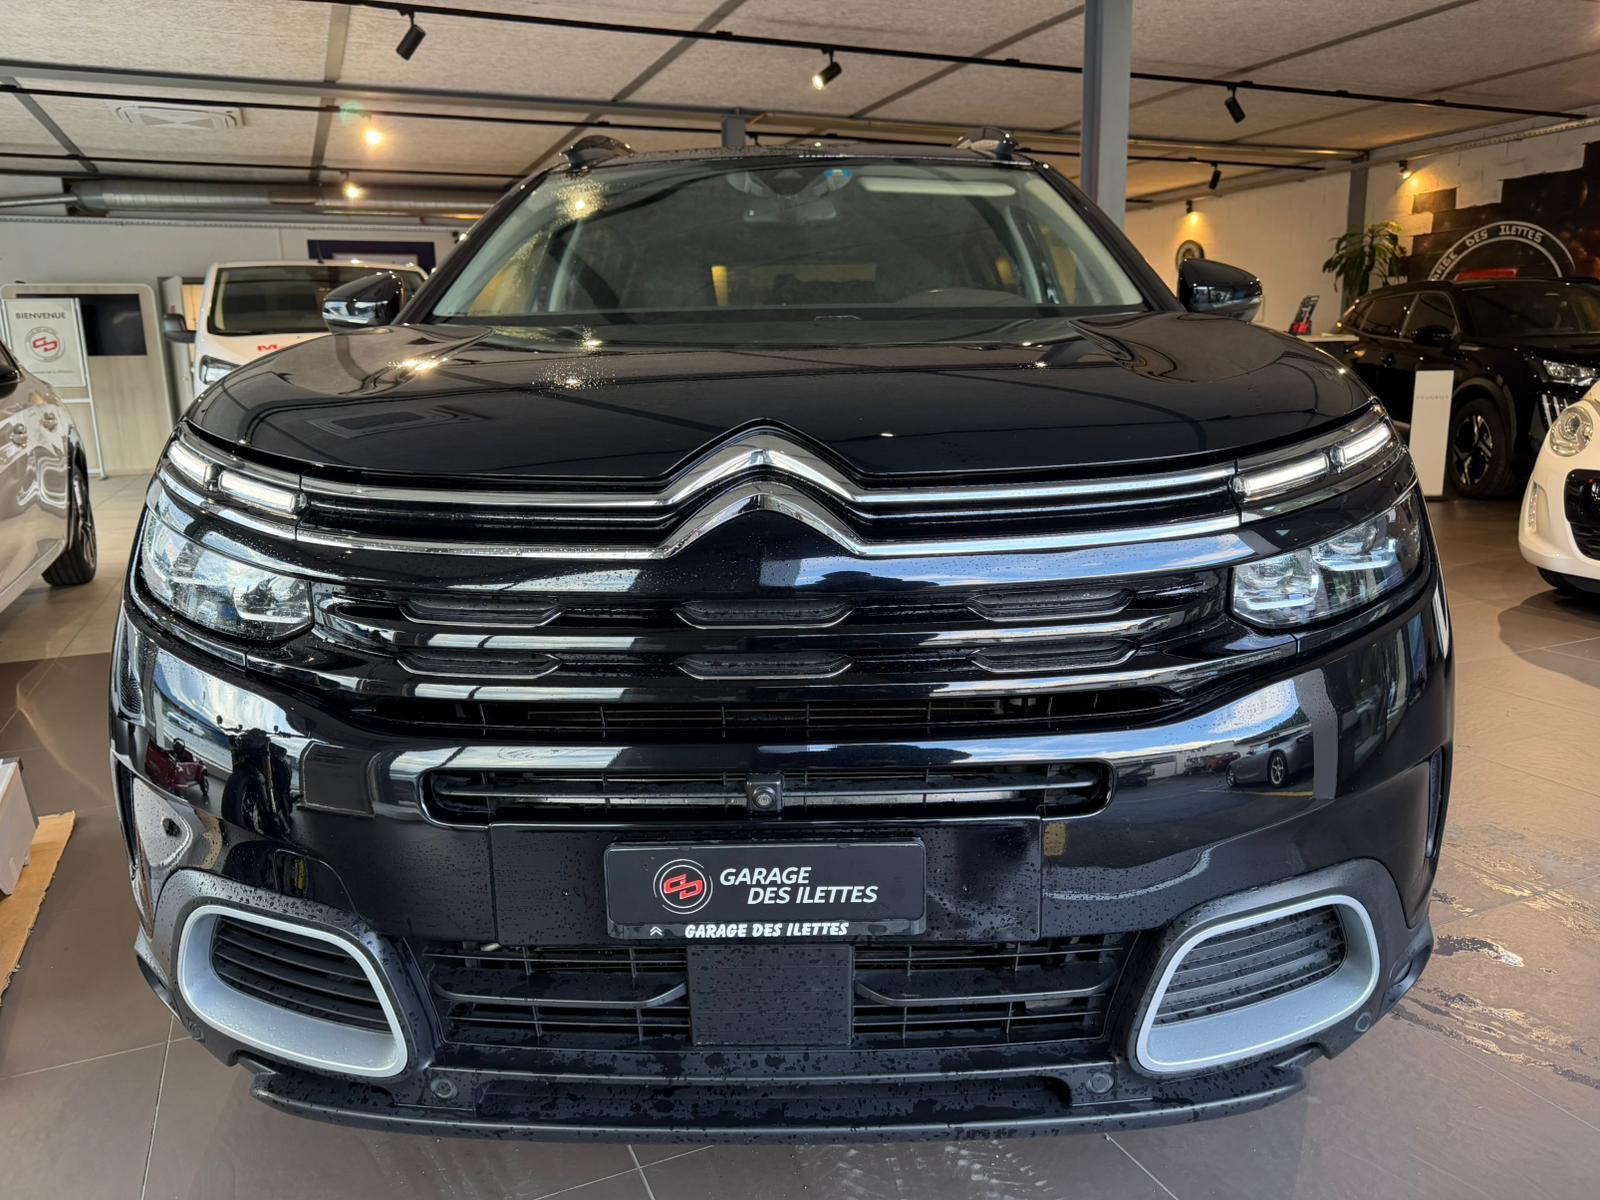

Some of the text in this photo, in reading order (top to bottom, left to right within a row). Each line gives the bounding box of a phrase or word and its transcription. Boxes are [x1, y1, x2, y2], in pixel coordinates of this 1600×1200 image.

[1465, 228, 1488, 247] DES
[1499, 224, 1544, 243] ILETTES
[15, 312, 67, 320] BIENVENUE
[719, 866, 812, 887] GARAGE
[747, 885, 879, 905] DES ILETTES
[684, 922, 850, 939] GARAGE DES ILETTES
